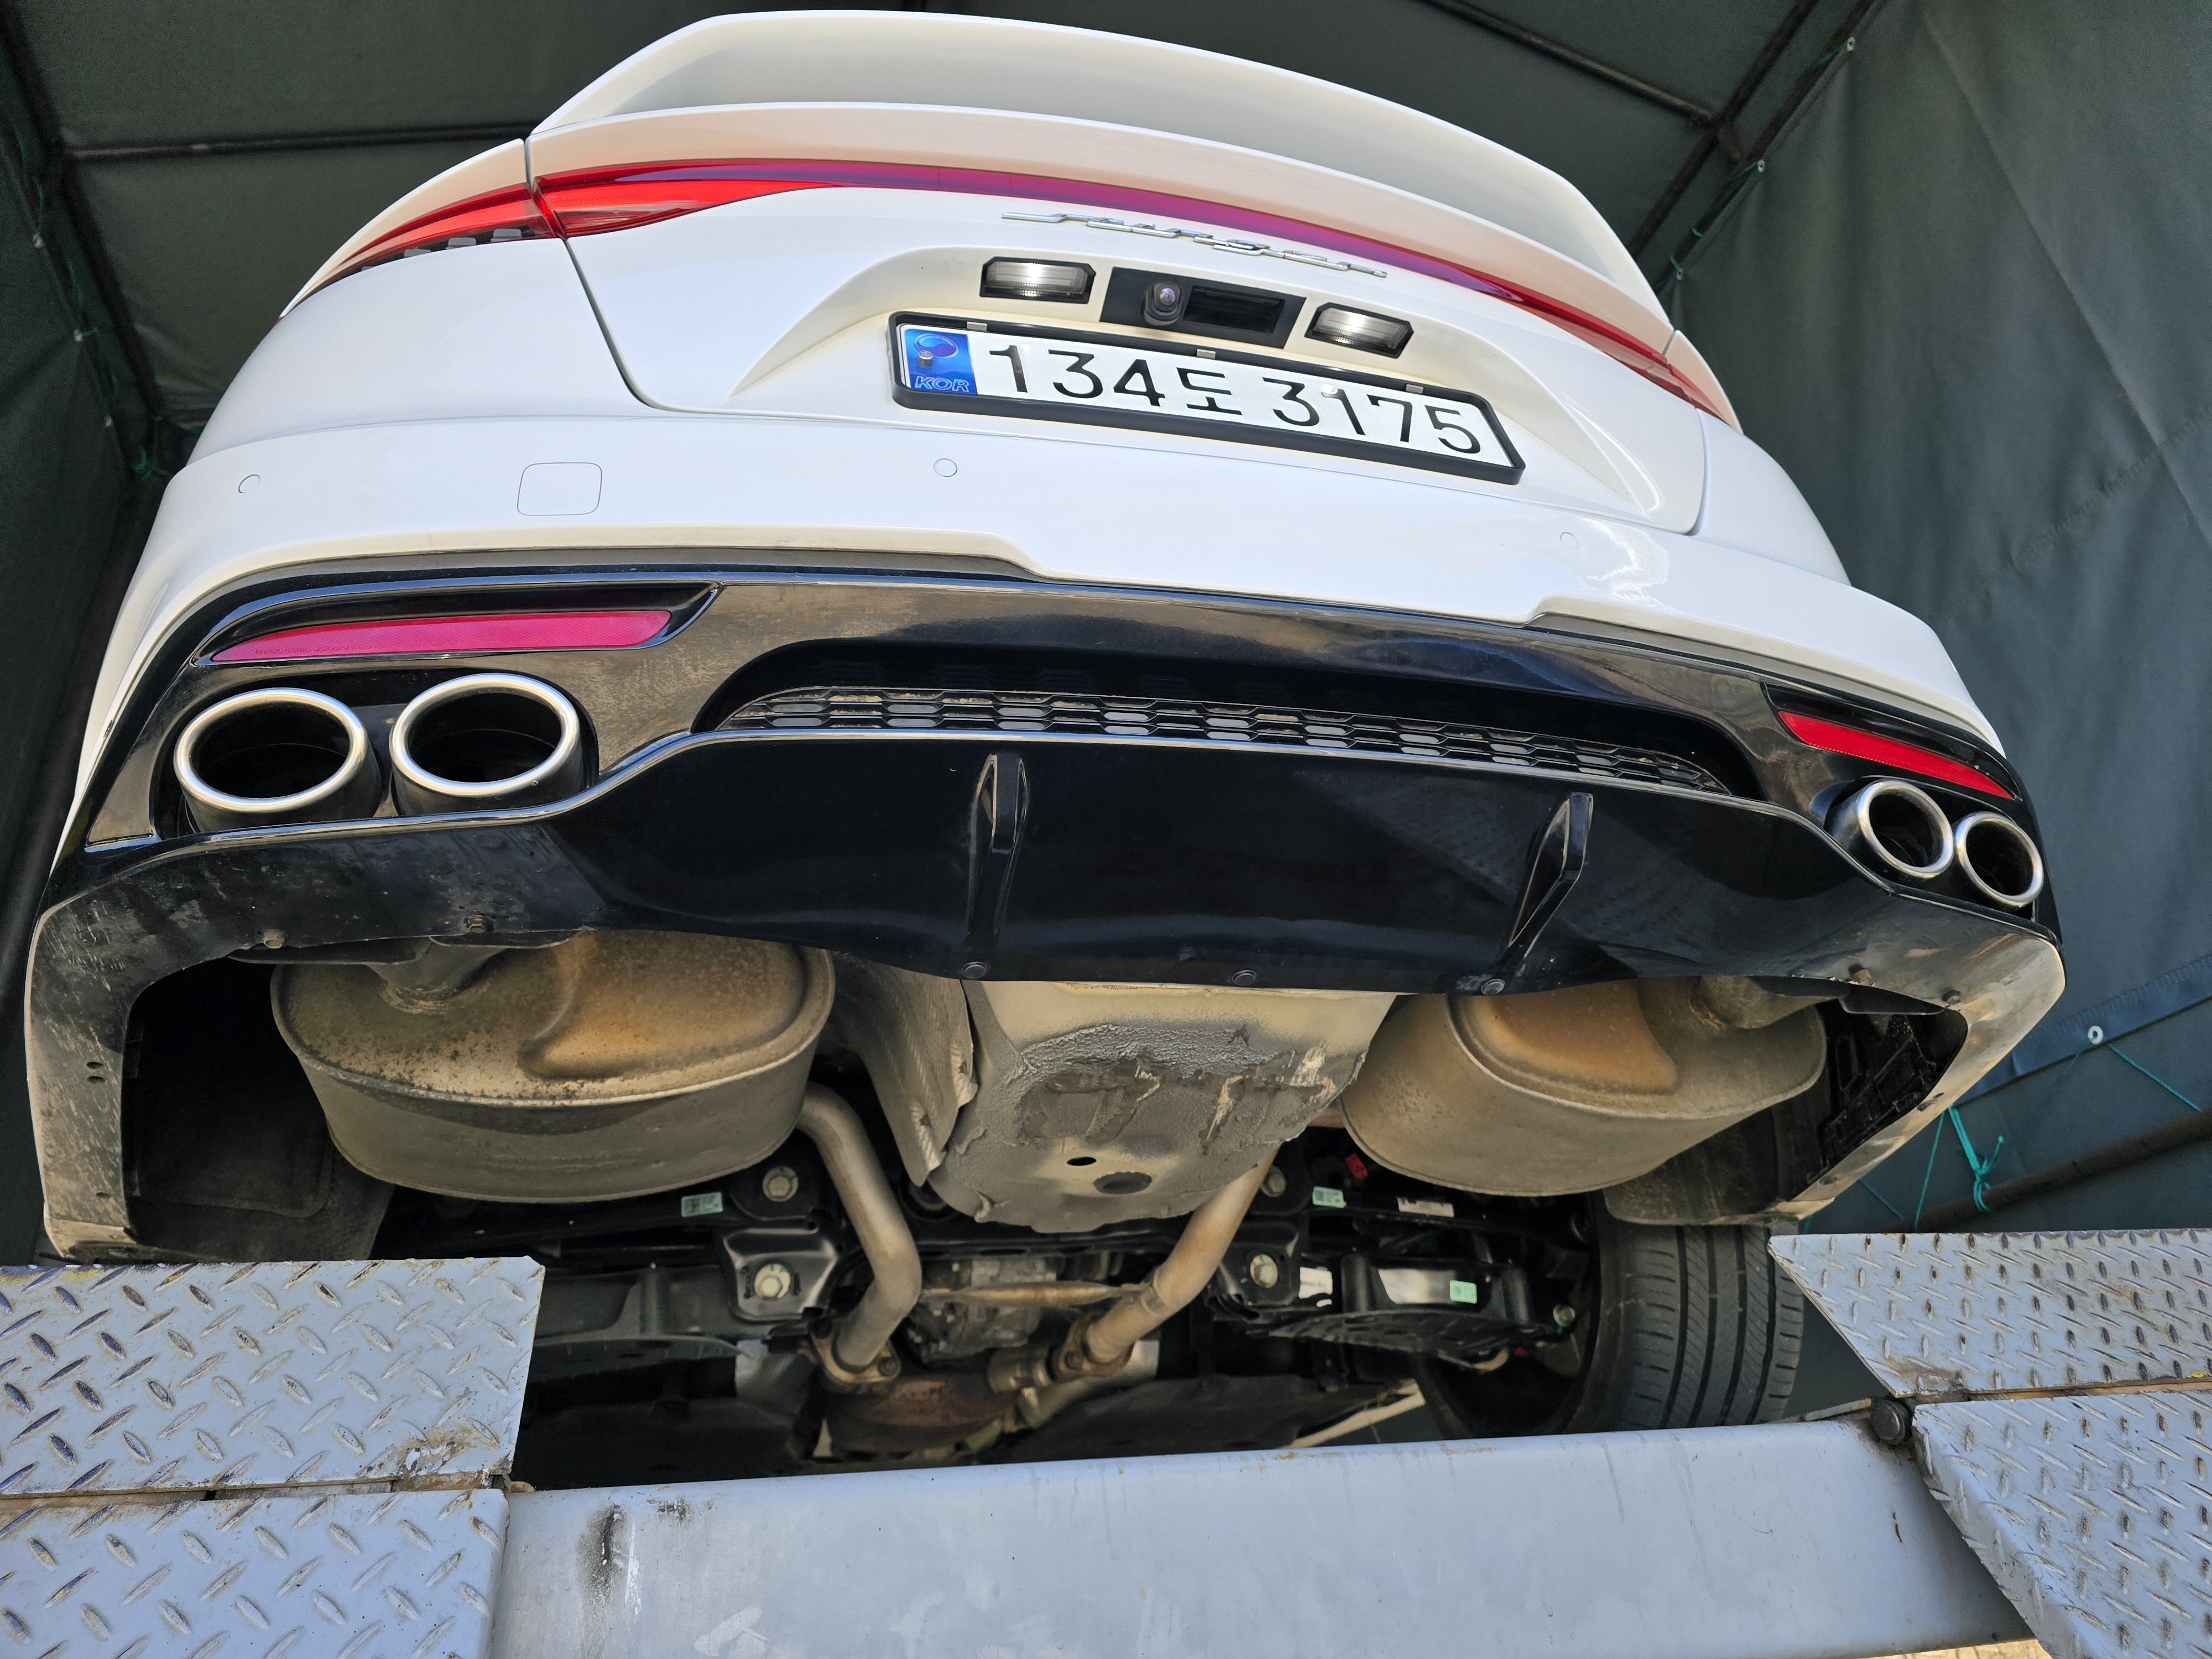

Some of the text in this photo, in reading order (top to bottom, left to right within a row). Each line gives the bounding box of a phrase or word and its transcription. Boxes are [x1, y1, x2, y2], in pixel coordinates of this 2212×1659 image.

[914, 375, 970, 393] KOR
[989, 345, 1481, 455] 134도 3175
